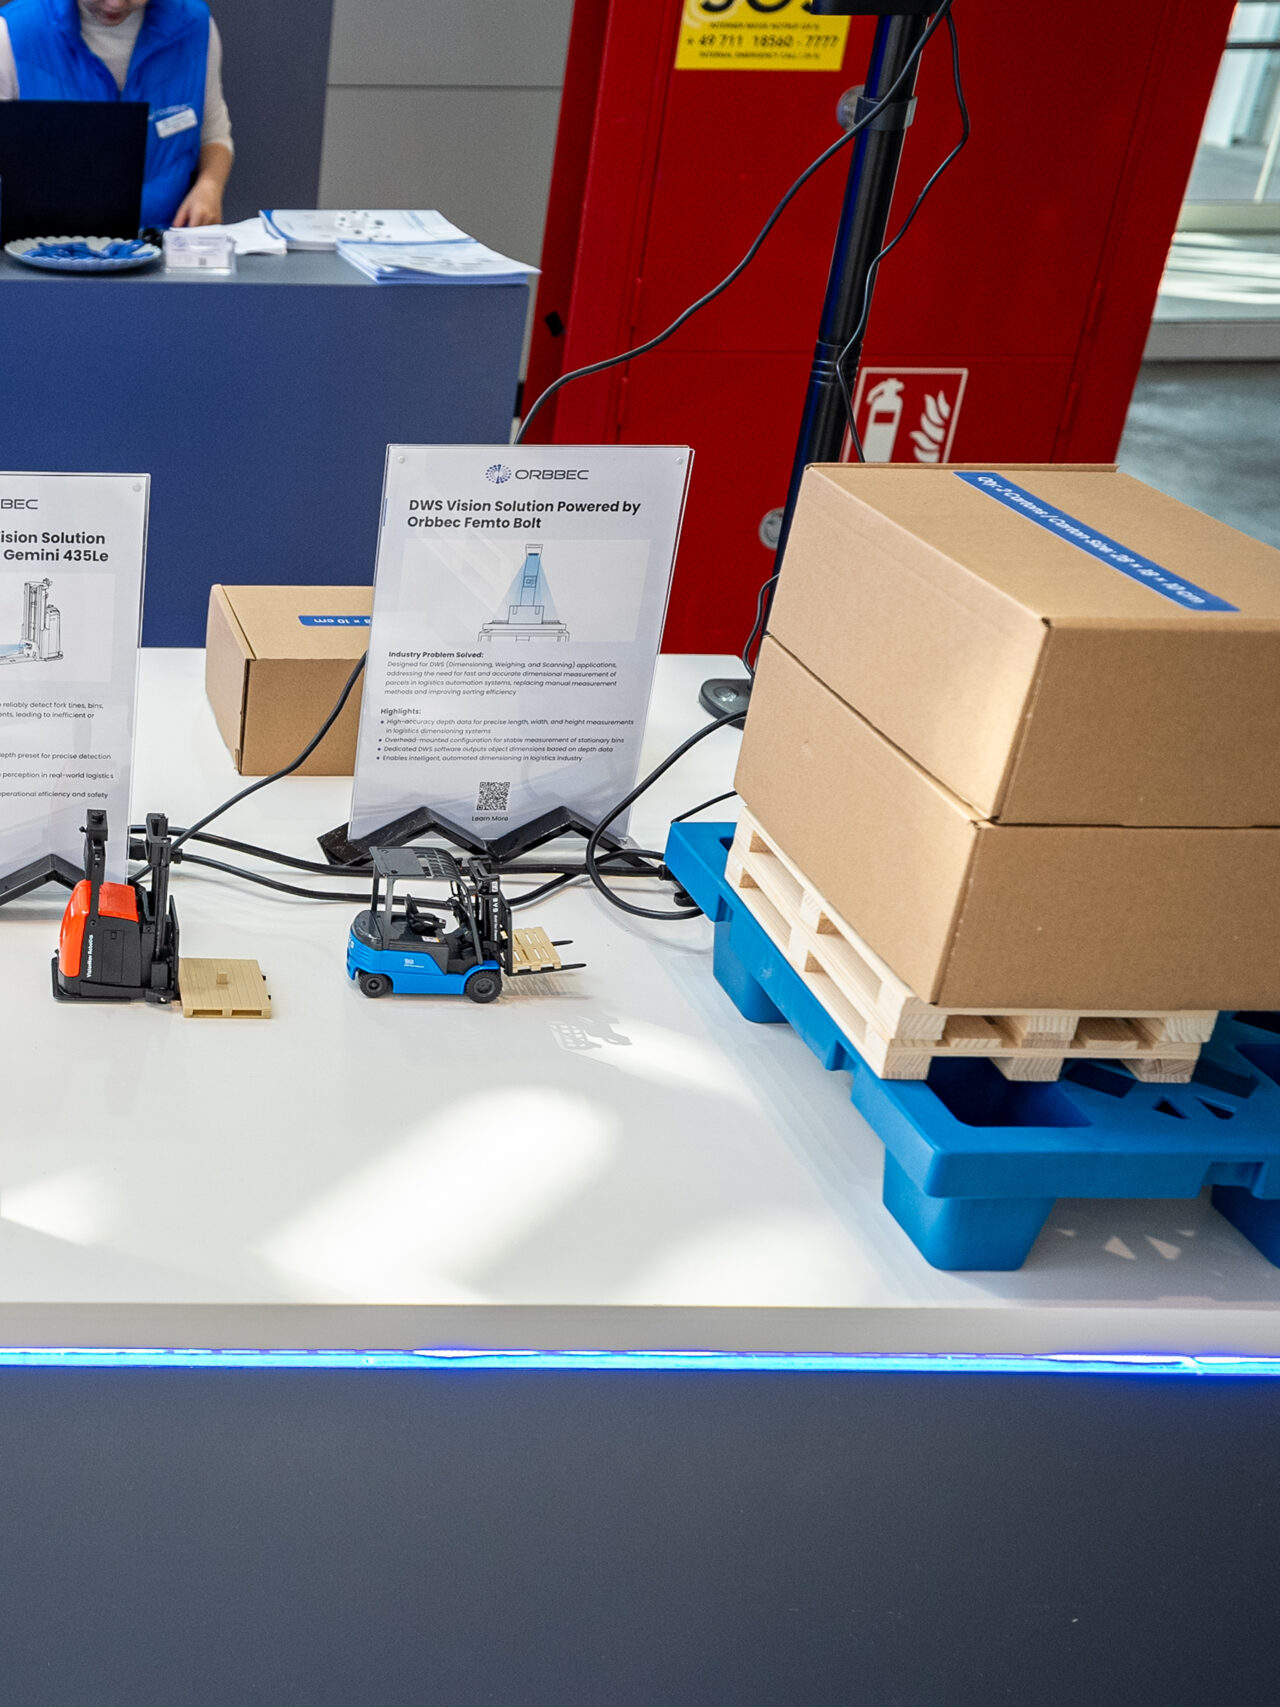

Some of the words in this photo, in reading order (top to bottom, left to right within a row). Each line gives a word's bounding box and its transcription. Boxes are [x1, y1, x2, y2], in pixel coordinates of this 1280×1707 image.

[699, 35, 716, 46] 49
[720, 35, 743, 46] 711
[805, 35, 839, 48] 7777
[515, 470, 589, 480] ORBBEC
[409, 500, 443, 511] DWS
[447, 499, 492, 512] Vision
[495, 500, 553, 512] Solution
[557, 501, 619, 512] Powered
[622, 501, 641, 516] by
[408, 516, 461, 528] Orbbec
[464, 517, 510, 529] Femto
[514, 517, 541, 529] Bolt
[41, 532, 106, 544] Solution
[4, 549, 59, 562] Gemini
[63, 550, 108, 562] 435Le
[1048, 518, 1090, 540] Carton
[1176, 590, 1206, 603] cm
